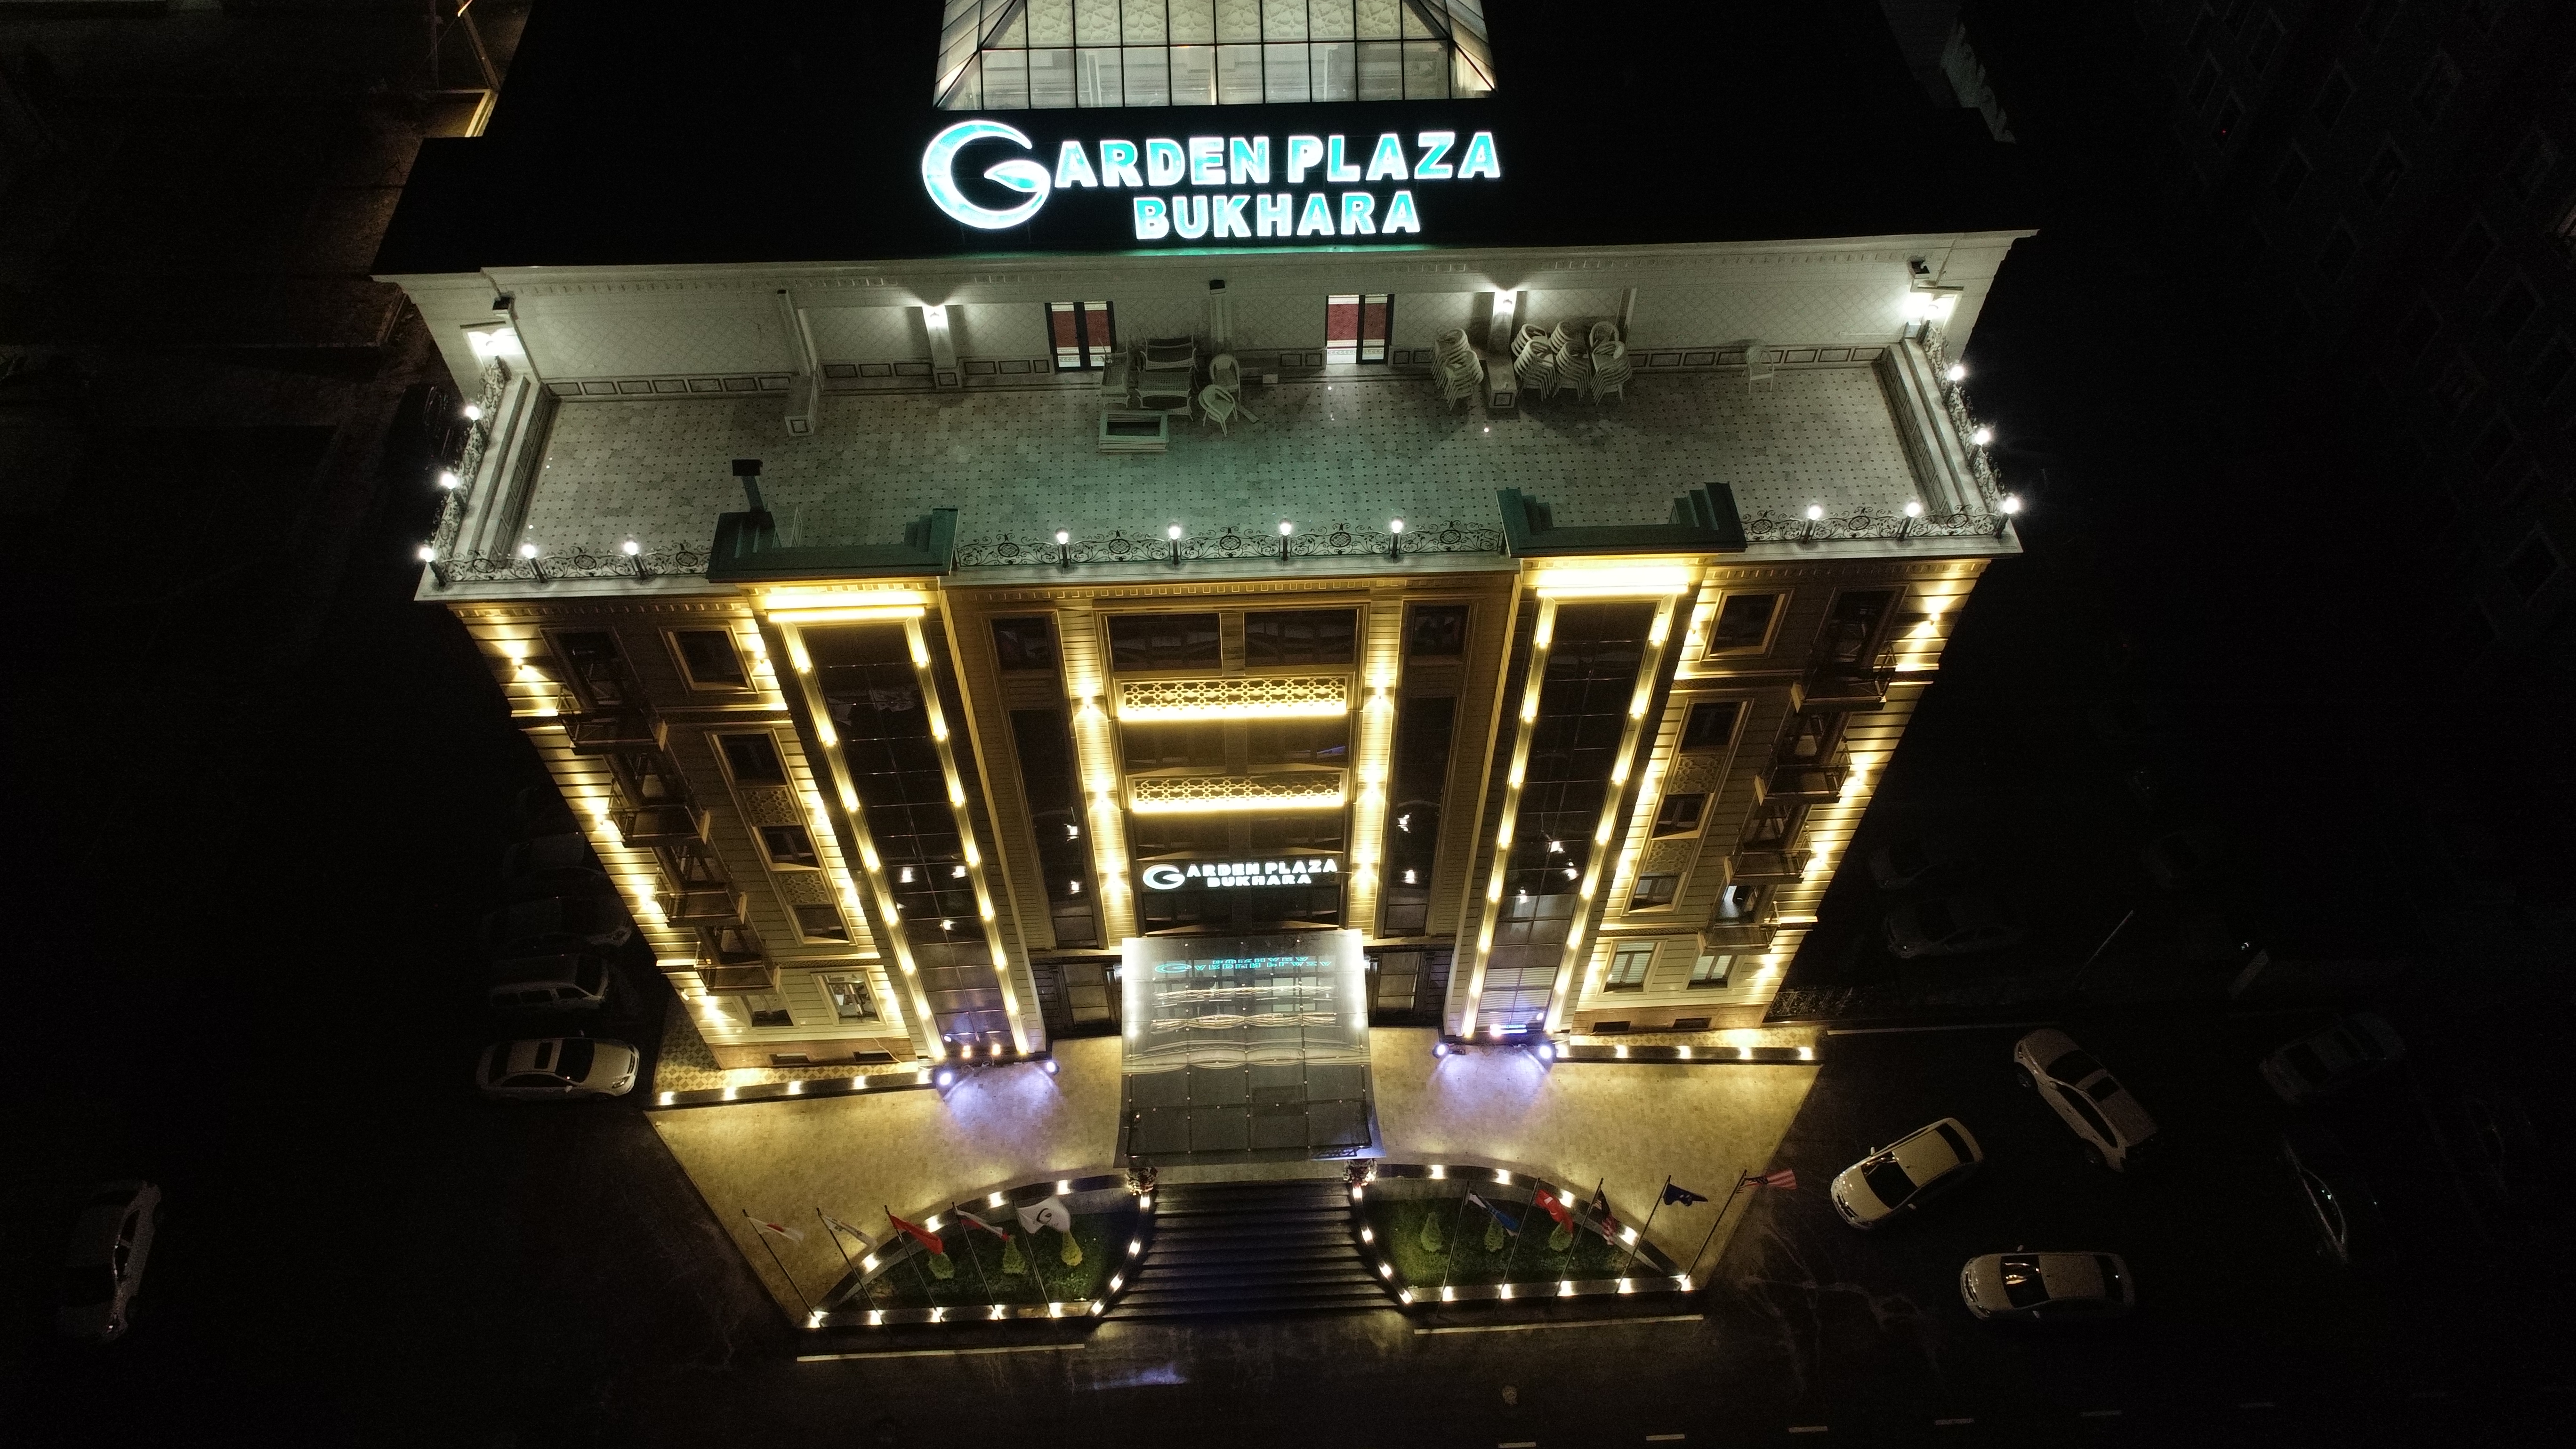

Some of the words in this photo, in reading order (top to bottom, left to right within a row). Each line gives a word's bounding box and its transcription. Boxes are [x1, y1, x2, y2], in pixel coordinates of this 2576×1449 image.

[921, 120, 1270, 229] GARDEN
[1288, 131, 1500, 184] PLAZA
[1133, 190, 1420, 240] BUKHARA
[1143, 862, 1260, 890] GARDEN
[1265, 859, 1338, 875] PLAZA
[1208, 874, 1312, 887] BUKHARA
